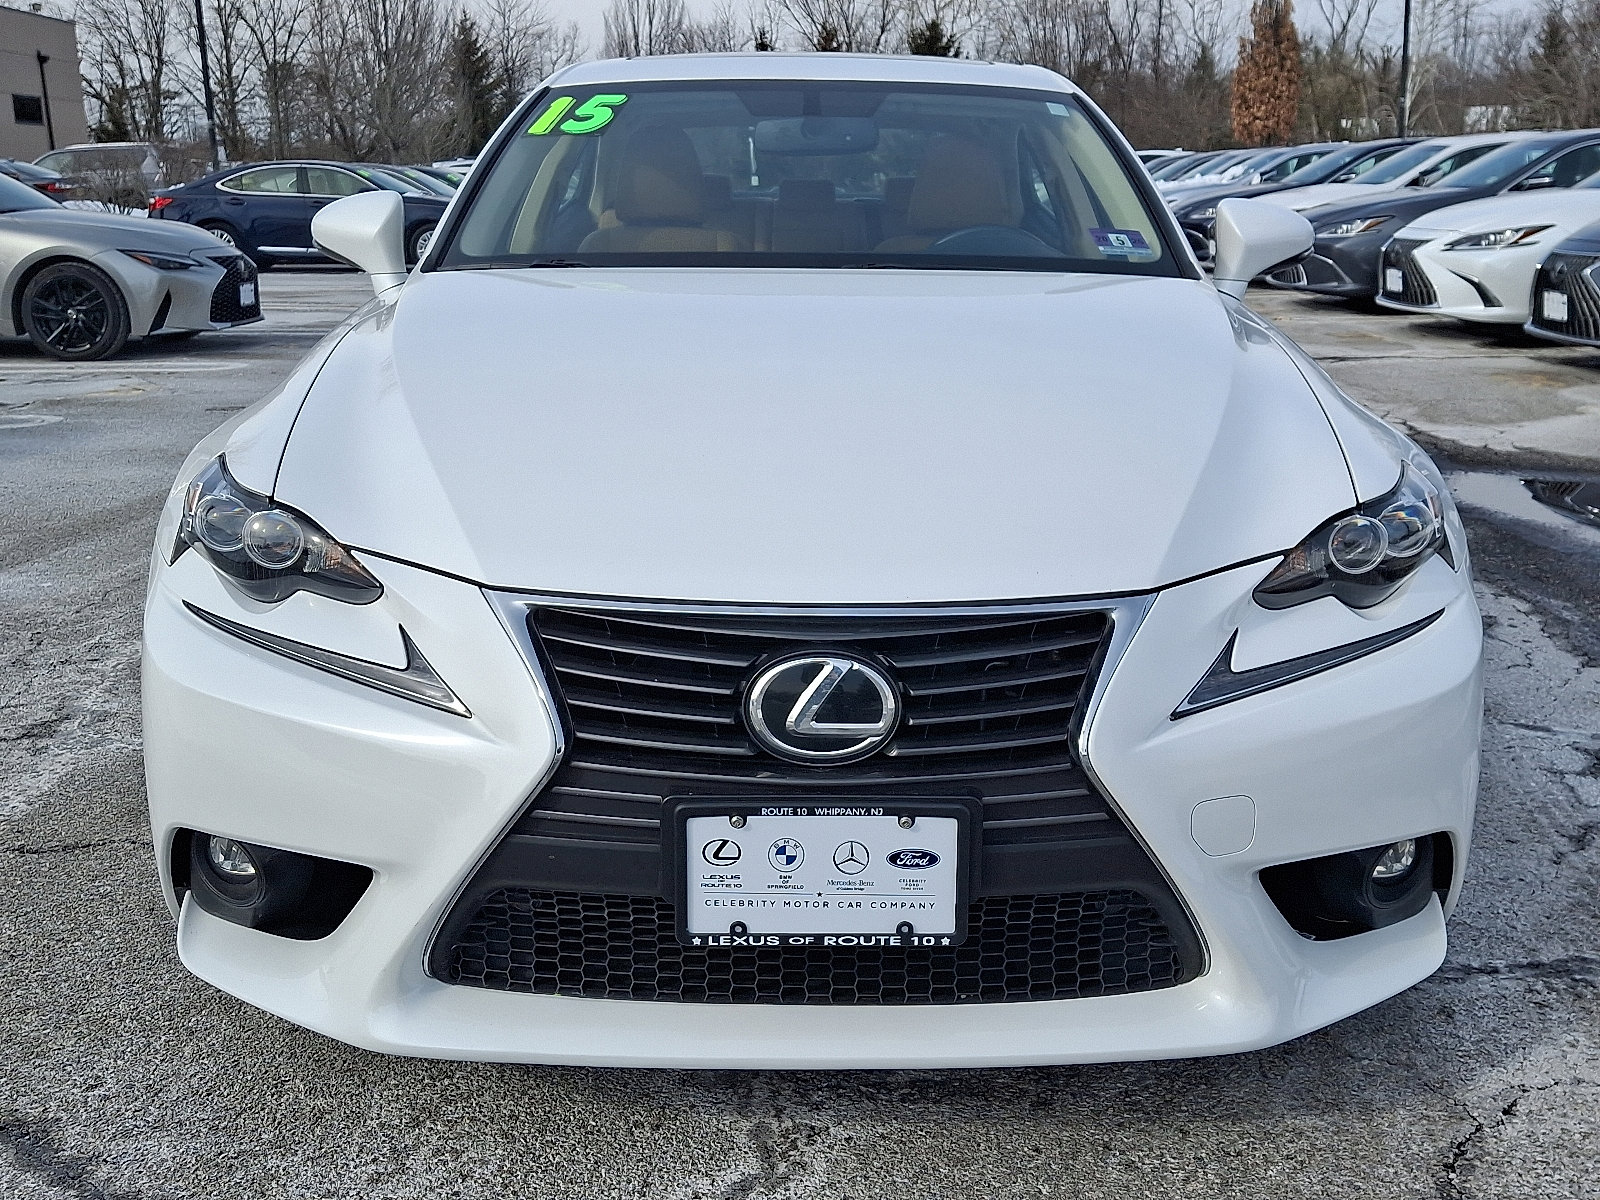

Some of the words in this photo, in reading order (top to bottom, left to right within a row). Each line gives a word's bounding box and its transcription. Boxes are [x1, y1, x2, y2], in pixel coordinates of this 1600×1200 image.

[526, 93, 629, 135] 15
[1116, 235, 1126, 246] 5
[761, 807, 794, 816] ROUTE
[796, 807, 808, 816] 10
[870, 807, 884, 816] NJ
[773, 839, 800, 849] BMW
[896, 851, 930, 866] Ford
[826, 879, 875, 887] Mercedes-Benz
[704, 899, 776, 908] CELEBRITY
[783, 900, 829, 909] MOTOR
[837, 901, 862, 909] CAR
[870, 901, 936, 910] COMPANY
[708, 935, 780, 946] LEXUS
[788, 936, 815, 945] OF
[823, 935, 901, 946] ROUTE
[910, 936, 935, 946] 10
